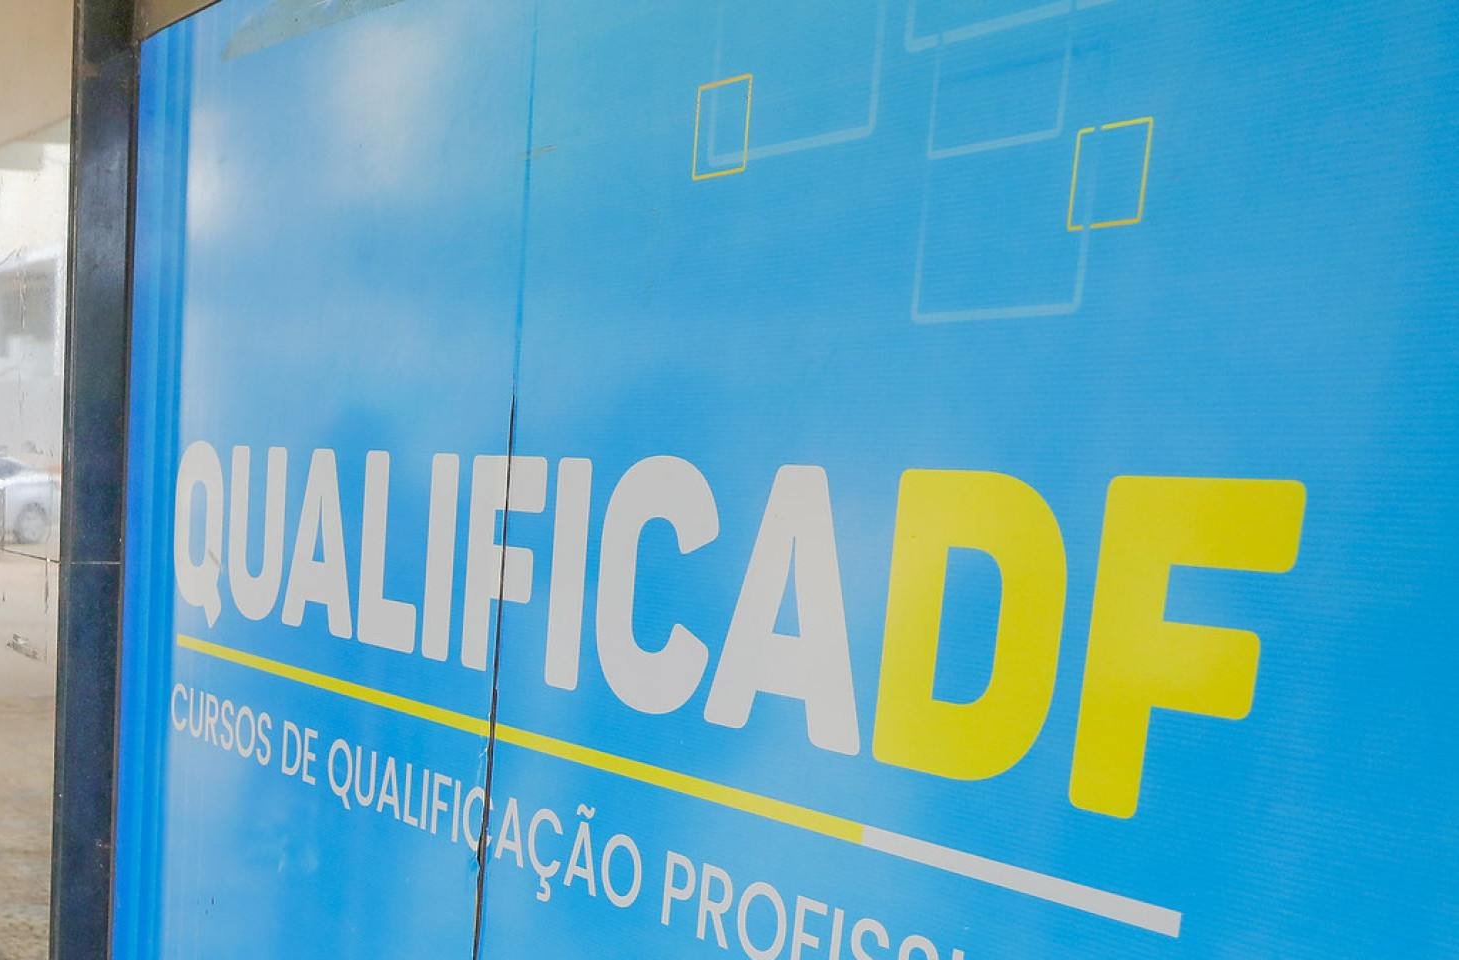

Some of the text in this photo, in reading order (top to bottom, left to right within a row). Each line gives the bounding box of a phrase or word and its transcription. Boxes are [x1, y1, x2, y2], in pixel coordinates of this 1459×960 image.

[170, 683, 273, 766] CURSOS
[281, 720, 318, 786] DE
[327, 738, 643, 909] QUALIFICAÇÃO
